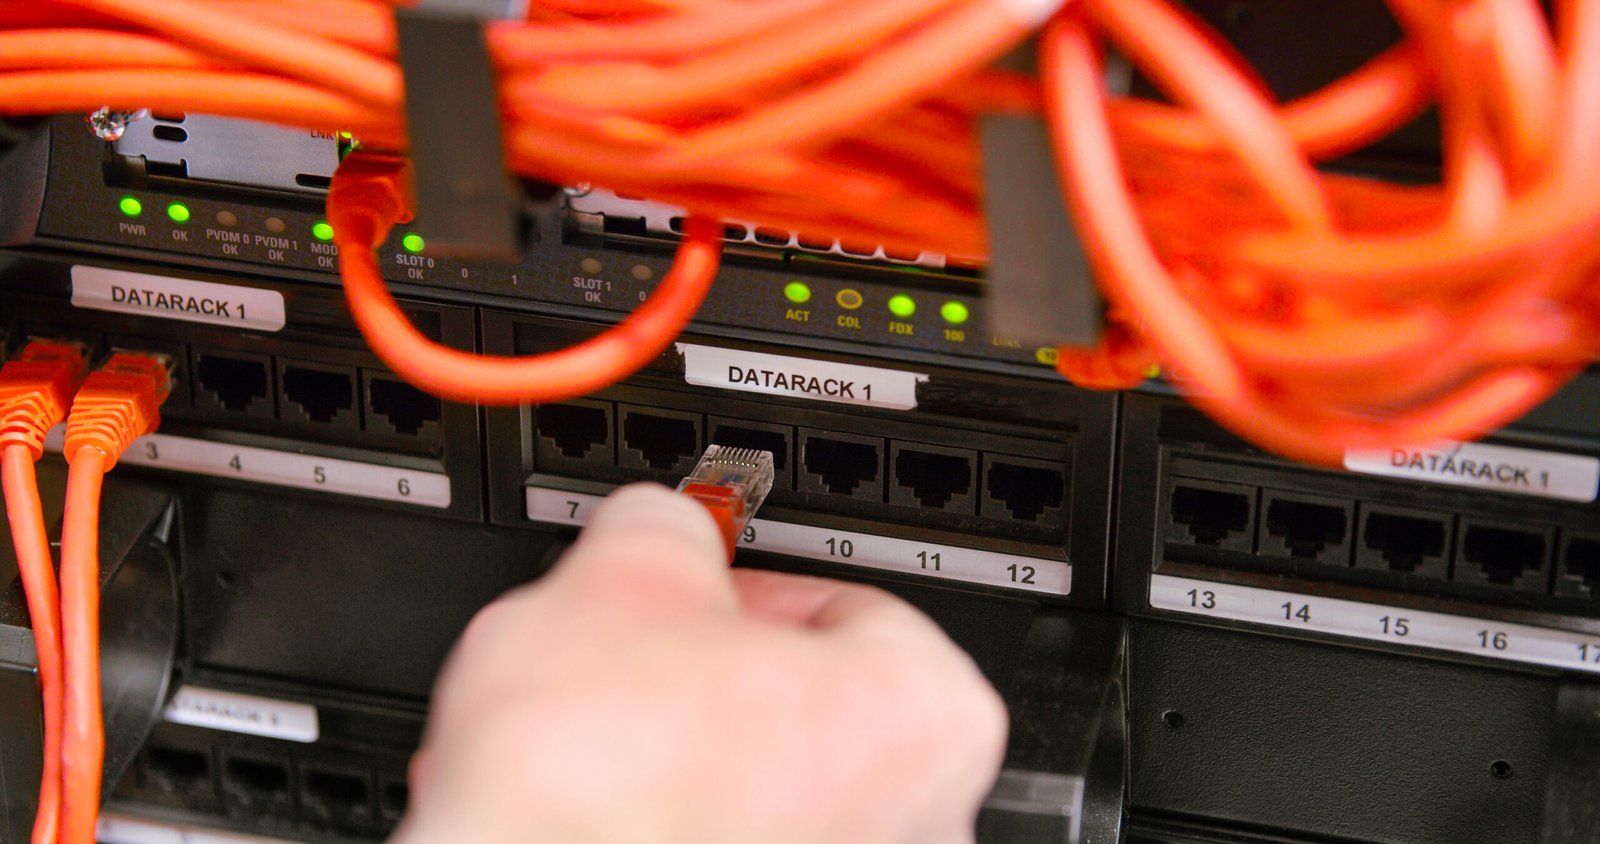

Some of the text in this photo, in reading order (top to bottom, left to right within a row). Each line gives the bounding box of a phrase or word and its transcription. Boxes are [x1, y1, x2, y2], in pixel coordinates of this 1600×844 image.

[310, 129, 333, 140] LNK
[119, 222, 146, 236] PWR
[172, 229, 188, 242] OK
[206, 228, 240, 243] PVDM
[222, 243, 238, 255] OK
[255, 235, 298, 250] PVDM 1
[311, 242, 338, 256] MOD
[268, 250, 284, 262] OK
[317, 256, 334, 268] OK
[396, 253, 435, 268] SLOT 0
[407, 267, 424, 280] OK
[461, 267, 469, 279] 0
[512, 274, 518, 285] 1
[572, 276, 612, 292] SLOT 1
[111, 285, 245, 319] DATARACK 1
[585, 291, 602, 303] OK
[785, 309, 811, 322] ACT
[836, 315, 862, 329] COL
[889, 321, 914, 336] FDX
[944, 329, 965, 342] 100
[728, 365, 872, 401] DATARACK 1
[145, 441, 410, 496] 3 4 5 6
[1391, 448, 1550, 488] DATARACK 1
[566, 500, 1036, 585] 7 9 10 11 12
[1186, 588, 1217, 609] 13
[1281, 601, 1312, 623] 14
[1379, 615, 1410, 637] 15
[1478, 629, 1508, 651] 16
